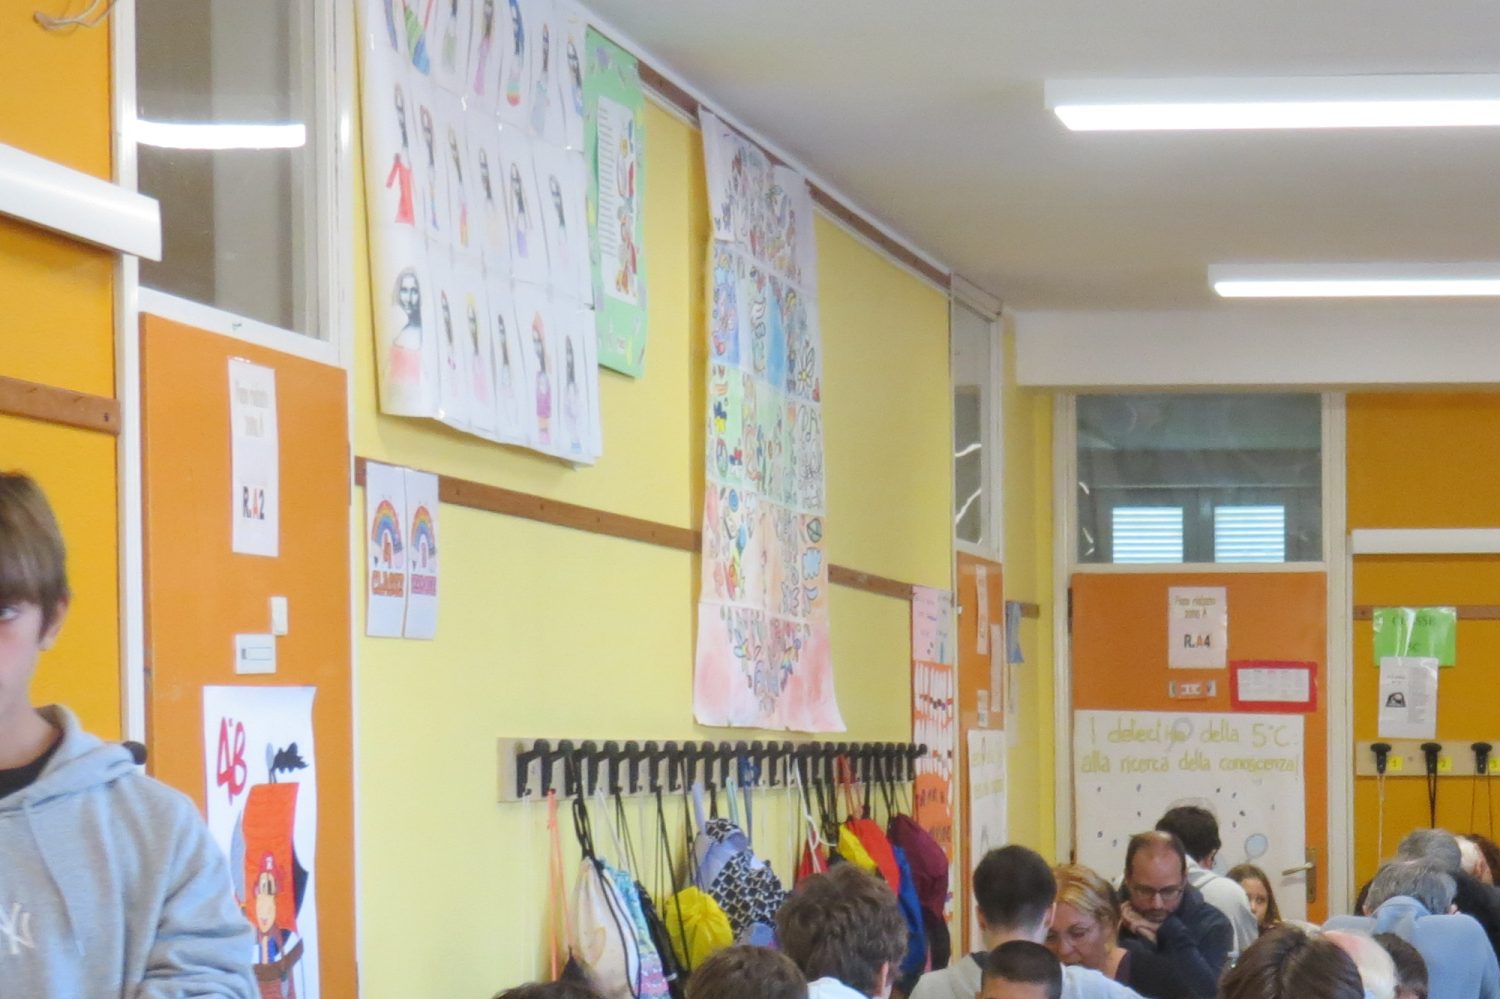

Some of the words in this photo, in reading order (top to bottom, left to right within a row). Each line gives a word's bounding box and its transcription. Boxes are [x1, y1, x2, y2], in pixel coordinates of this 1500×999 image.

[1184, 634, 1211, 649] R.A4
[1201, 718, 1240, 743] della
[1081, 750, 1111, 773] alla
[1120, 755, 1170, 774] ricerca
[1178, 750, 1211, 772] della
